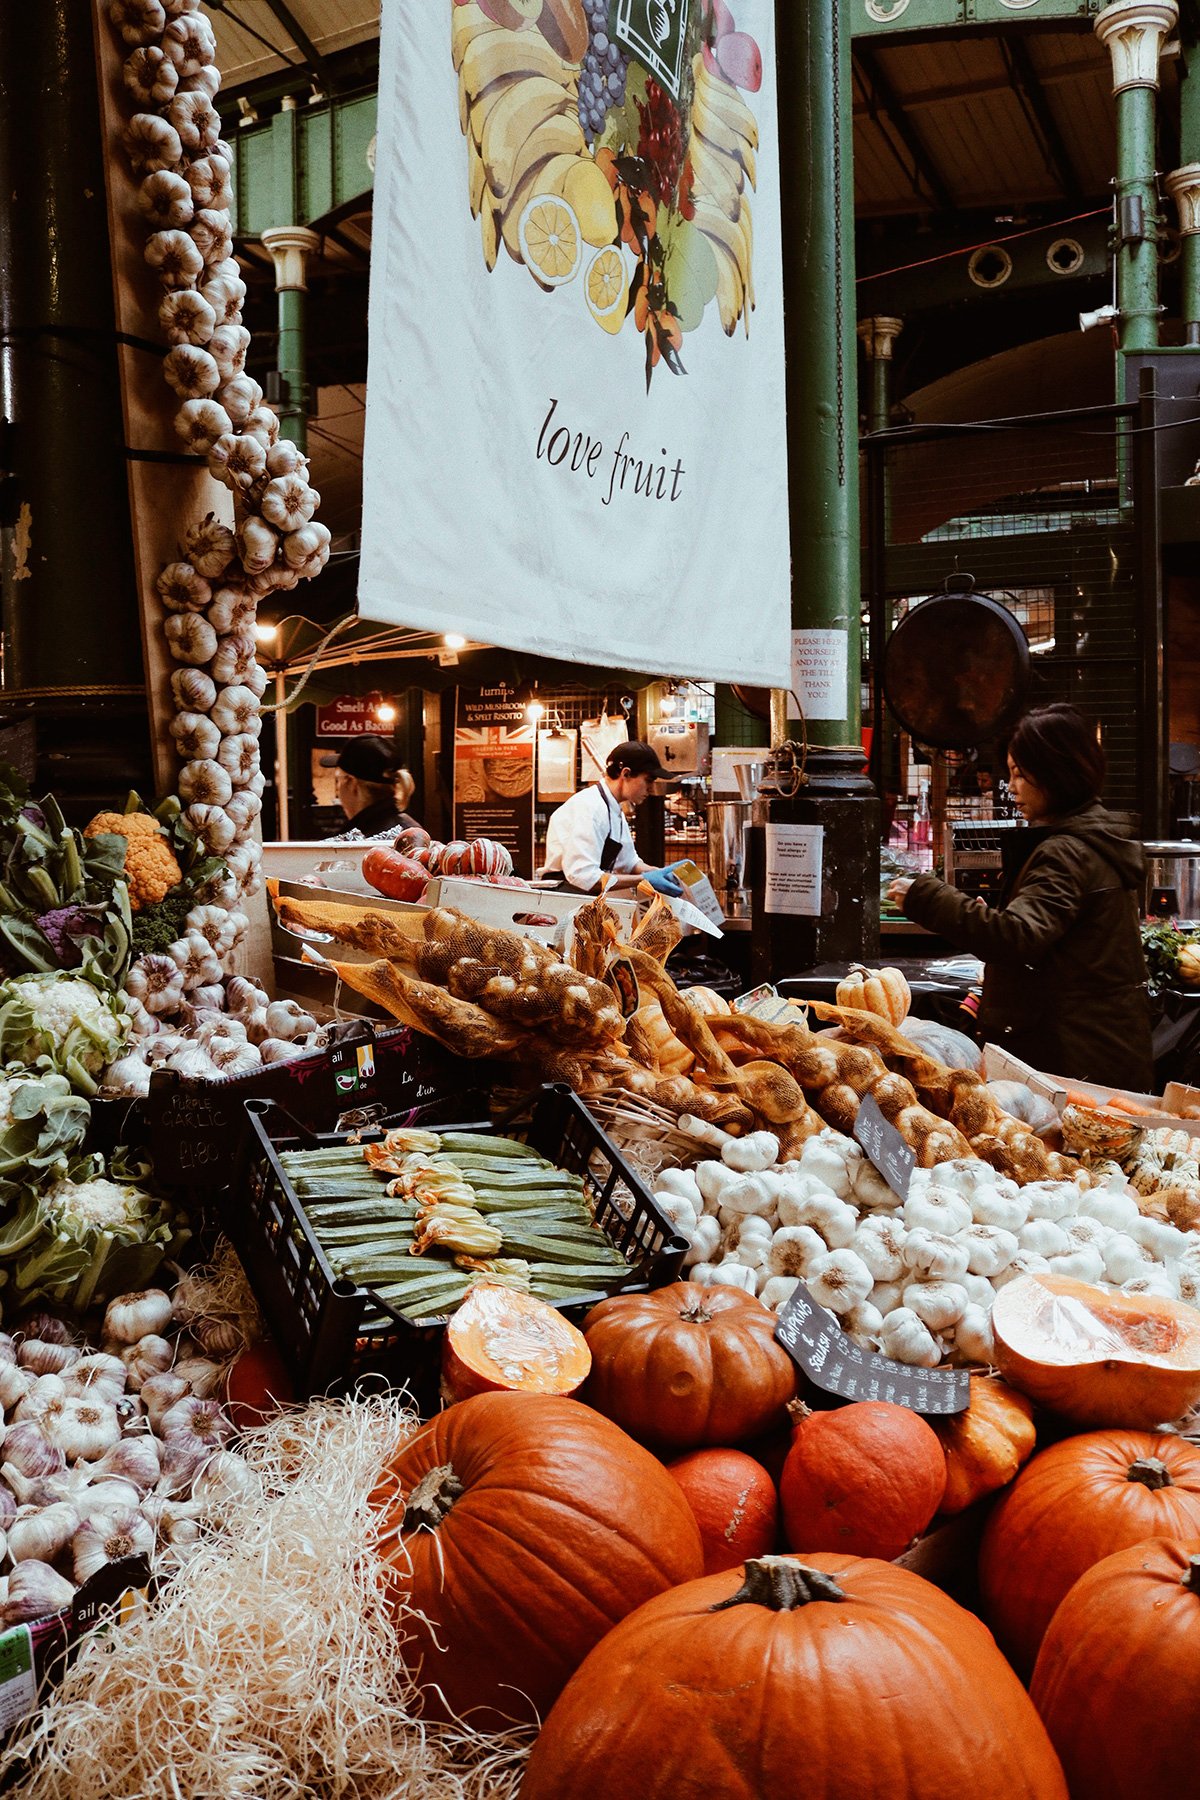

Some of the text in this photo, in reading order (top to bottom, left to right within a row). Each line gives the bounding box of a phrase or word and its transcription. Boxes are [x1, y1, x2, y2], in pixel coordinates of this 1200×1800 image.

[537, 398, 686, 505] love fruit
[795, 638, 820, 646] PLEASE
[798, 648, 837, 656] YOURSELF
[336, 702, 364, 713] Smelt
[465, 704, 484, 712] WILD
[493, 712, 523, 720] RISOTTO
[321, 720, 394, 731] Good As Bacon
[332, 1051, 343, 1063] ail
[402, 1071, 414, 1084] La
[416, 1085, 436, 1098] d'un
[172, 1095, 211, 1110] PURPLE
[162, 1111, 228, 1128] GARLIC
[779, 1299, 813, 1349] PUMPKINS
[802, 1334, 814, 1347] &
[809, 1332, 832, 1373] SQUASH
[78, 1602, 95, 1620] ail
